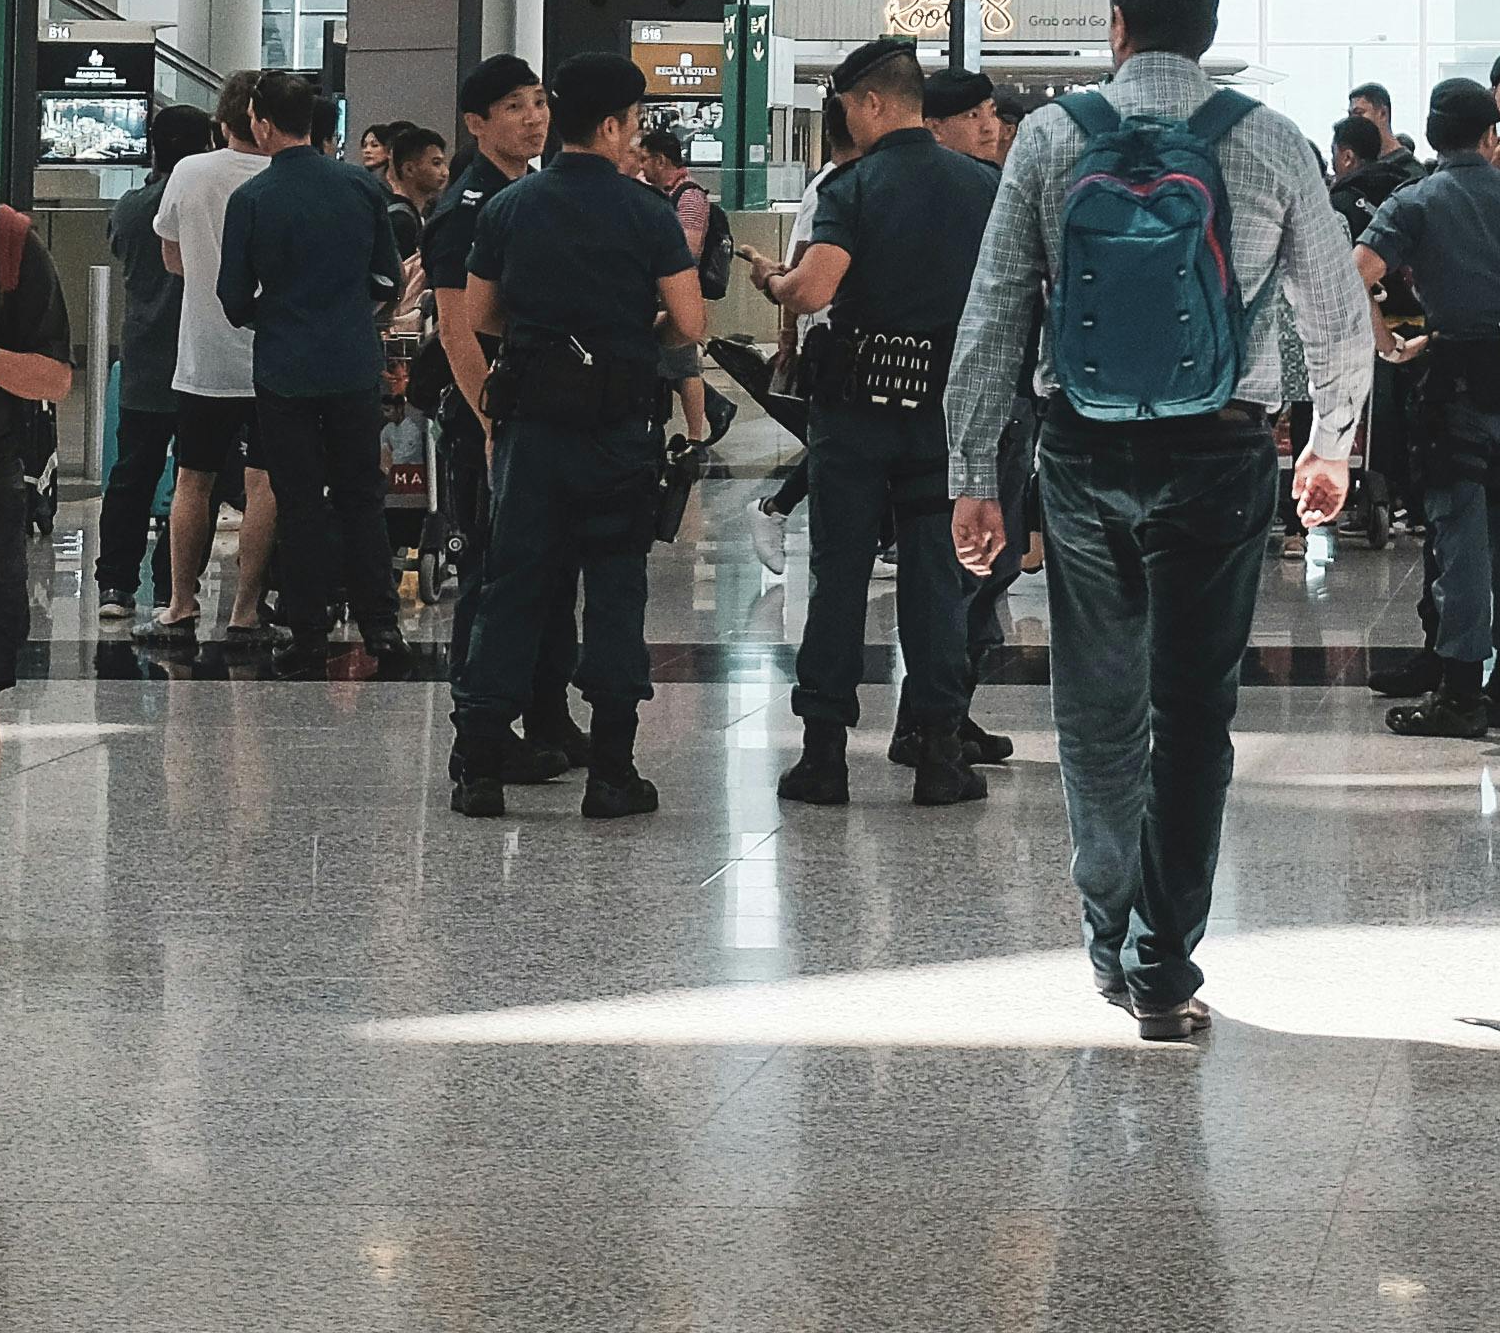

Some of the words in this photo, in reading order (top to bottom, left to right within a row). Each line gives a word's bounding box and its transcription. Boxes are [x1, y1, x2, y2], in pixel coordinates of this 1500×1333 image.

[1028, 15, 1059, 27] Grab
[1062, 14, 1086, 27] and
[1088, 15, 1107, 27] Go
[48, 26, 71, 40] B14
